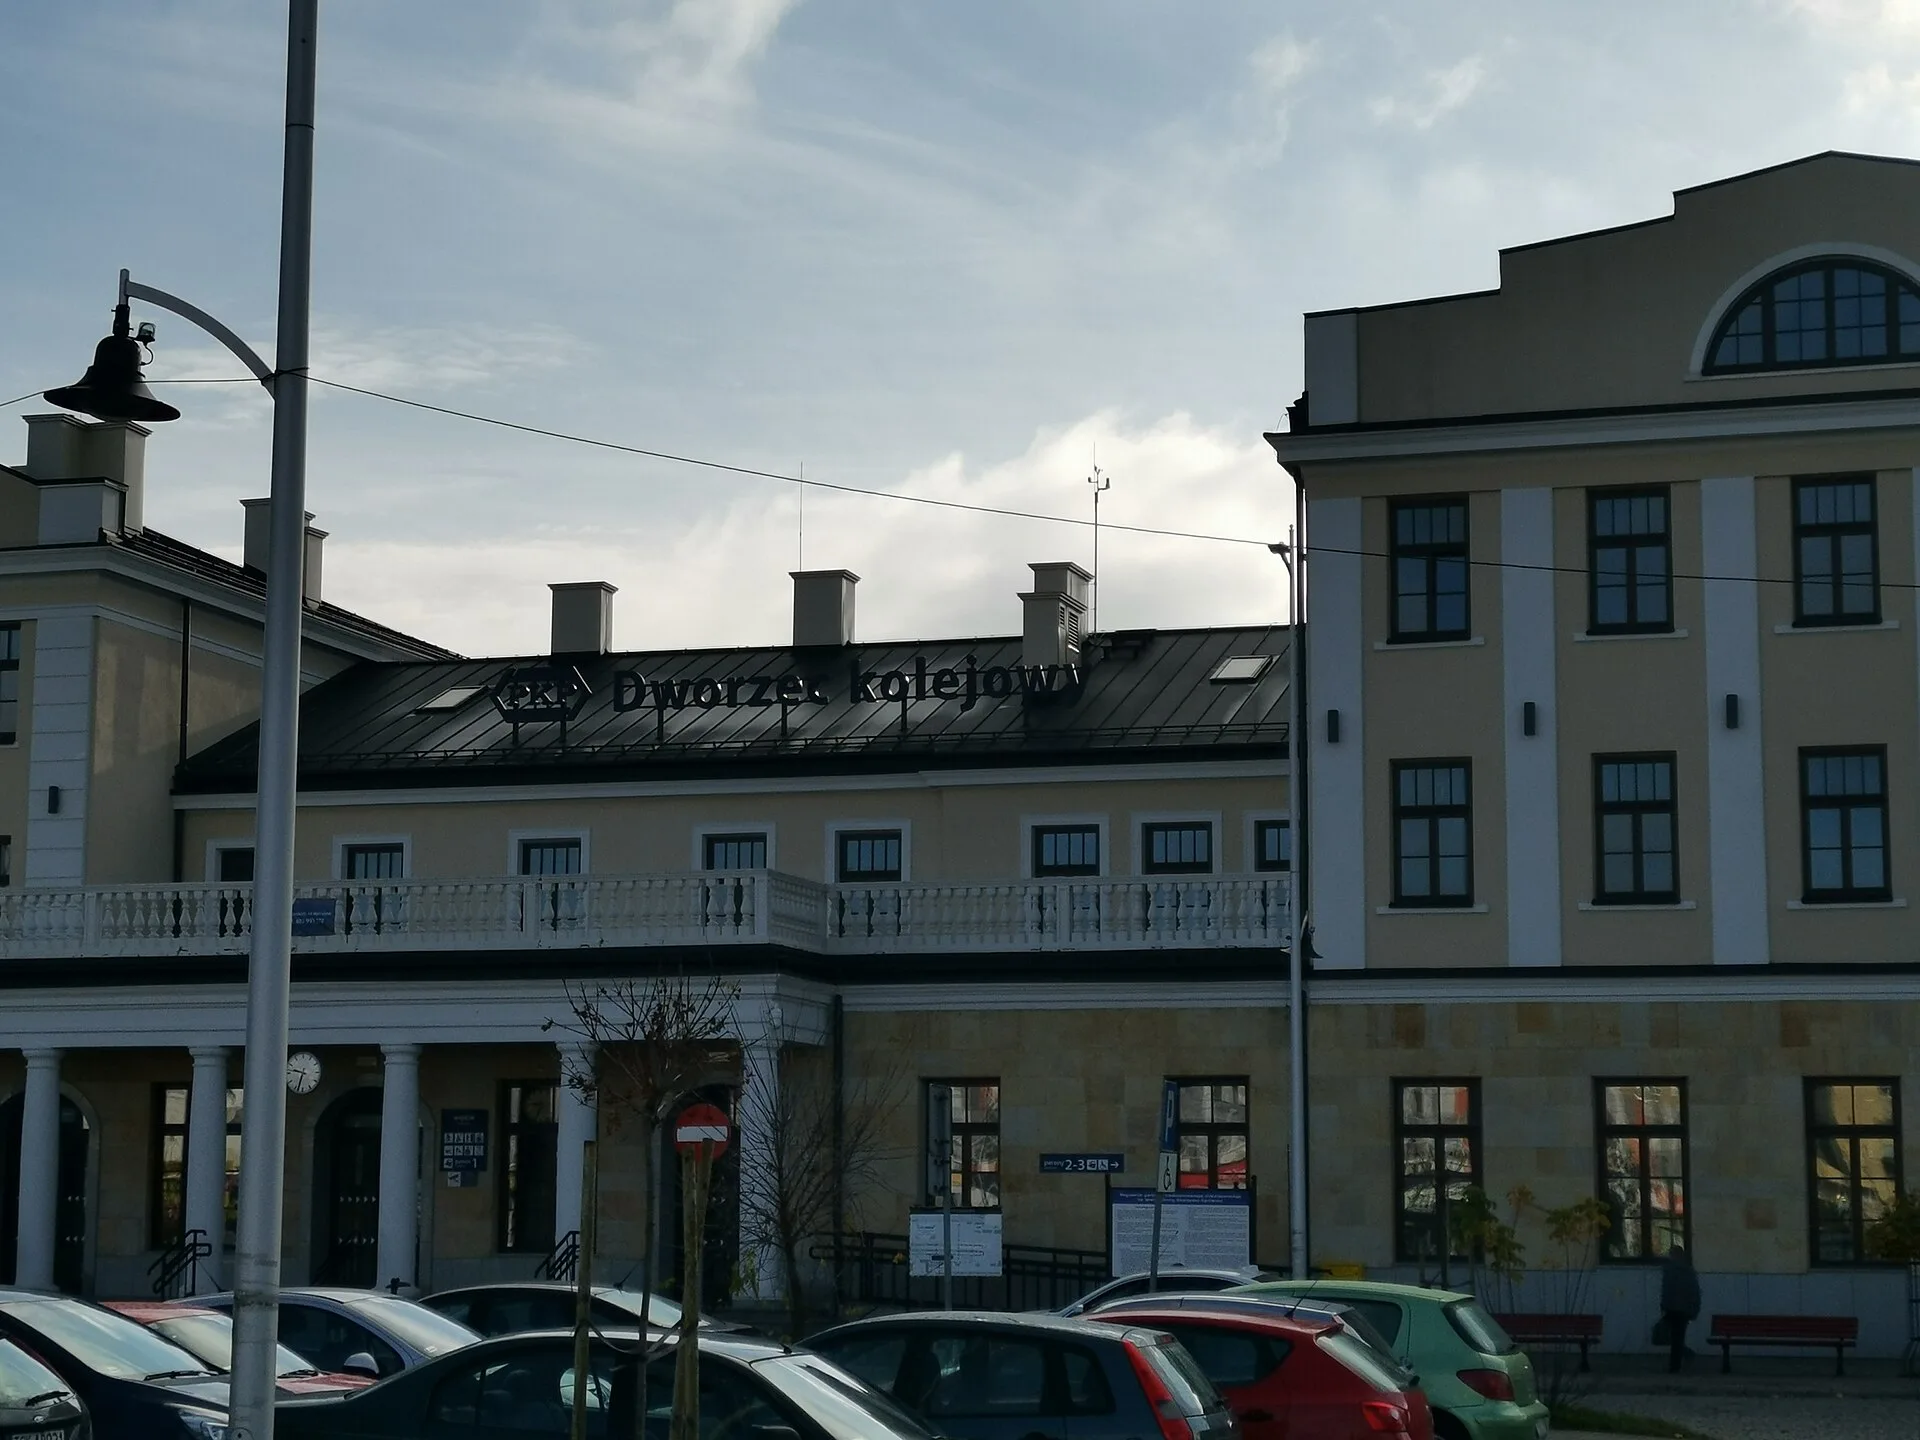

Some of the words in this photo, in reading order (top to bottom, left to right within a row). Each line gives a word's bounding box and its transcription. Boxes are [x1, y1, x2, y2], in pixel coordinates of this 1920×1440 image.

[506, 681, 578, 709] PKP
[613, 670, 830, 712] Dworzec
[850, 655, 1087, 711] kolejowy
[1065, 1159, 1086, 1171] 2-3
